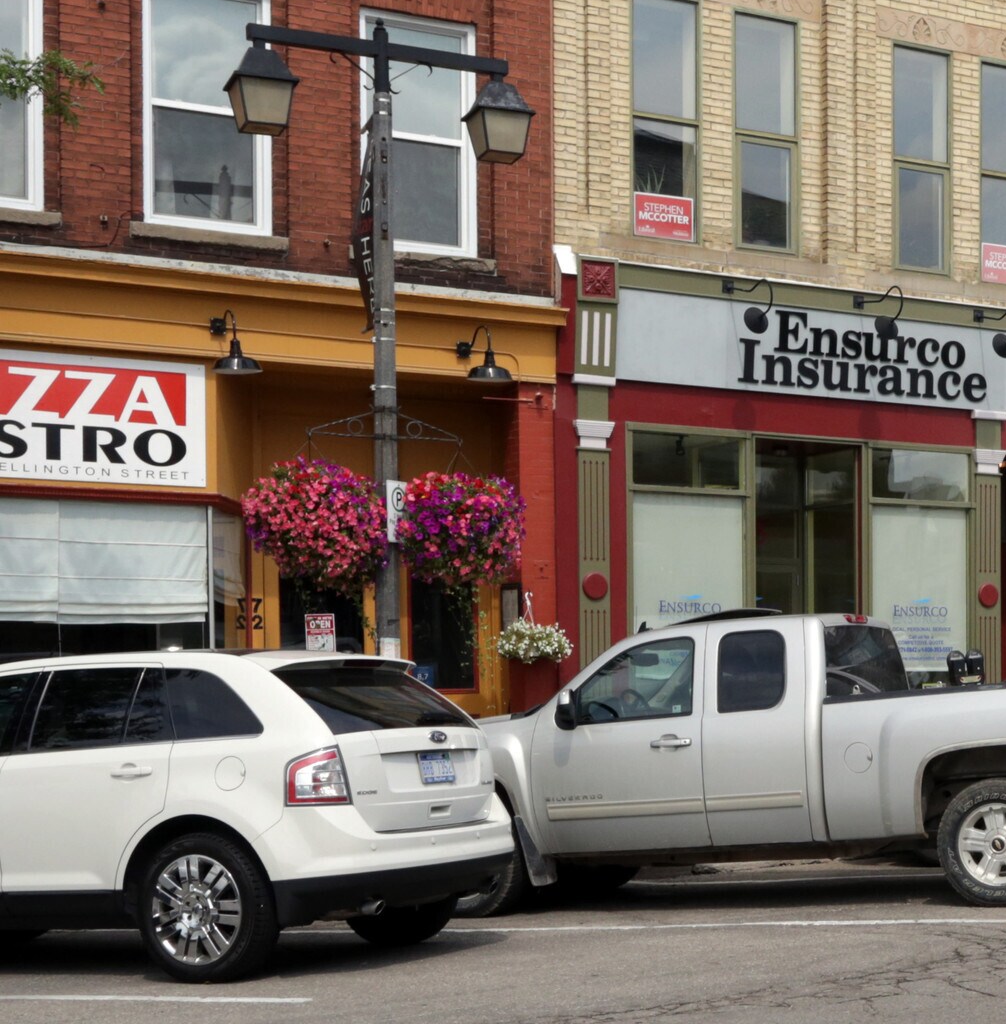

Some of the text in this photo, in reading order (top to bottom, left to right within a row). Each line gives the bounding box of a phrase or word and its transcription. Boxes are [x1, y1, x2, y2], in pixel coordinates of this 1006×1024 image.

[644, 202, 684, 215] STEPHEN
[638, 210, 690, 225] MCCOTTER
[773, 309, 966, 369] Ensurco
[737, 337, 988, 403] Insurance
[0, 419, 187, 467] STRO
[0, 462, 190, 480] ELLINGTON STREET
[658, 599, 722, 614] ENSURCO
[893, 604, 948, 617] ENSURCO
[545, 793, 603, 802] SILVERADO
